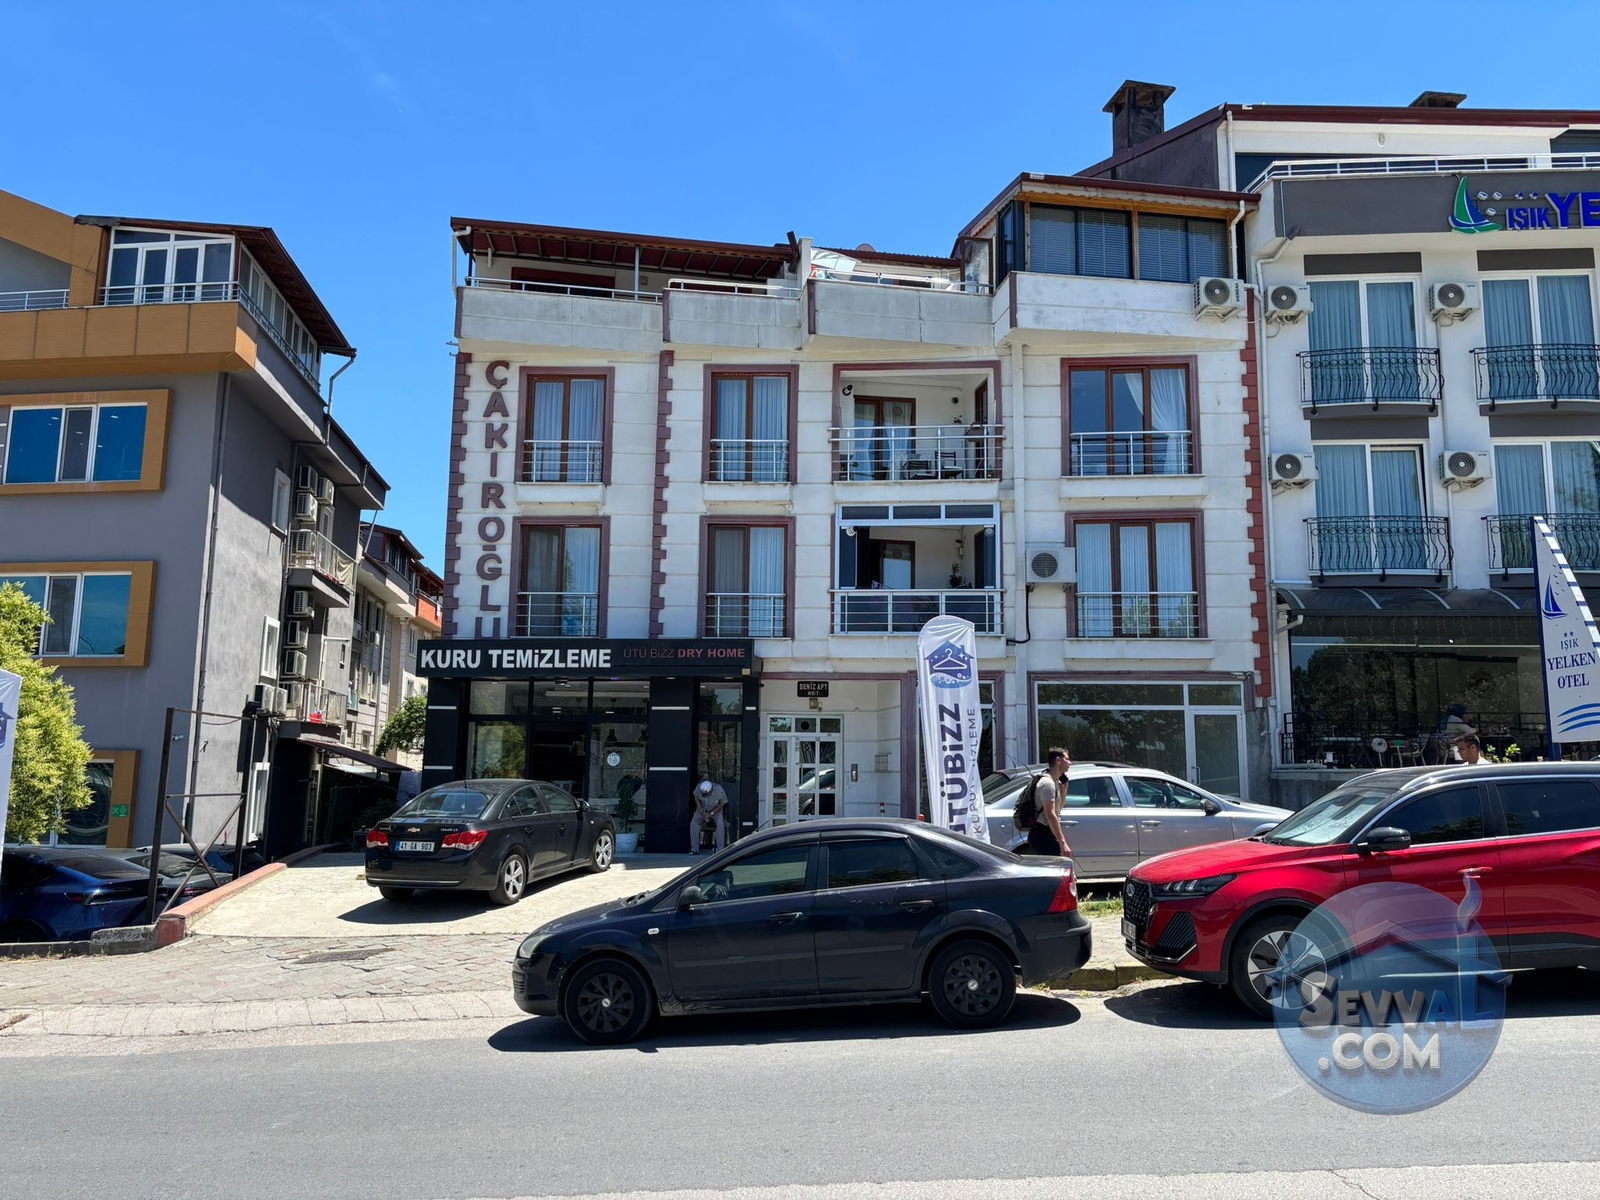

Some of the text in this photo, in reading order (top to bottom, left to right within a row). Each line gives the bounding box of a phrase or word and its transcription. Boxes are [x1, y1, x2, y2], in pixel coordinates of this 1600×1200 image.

[1506, 207, 1551, 231] IŞIK
[623, 646, 647, 659] ÜTÜ
[677, 648, 703, 658] DRY
[707, 648, 746, 658] HOME
[1560, 638, 1579, 651] IŞIK
[420, 649, 482, 669] KURU
[1547, 651, 1596, 671] YELKEN
[1557, 673, 1590, 689] OTEL
